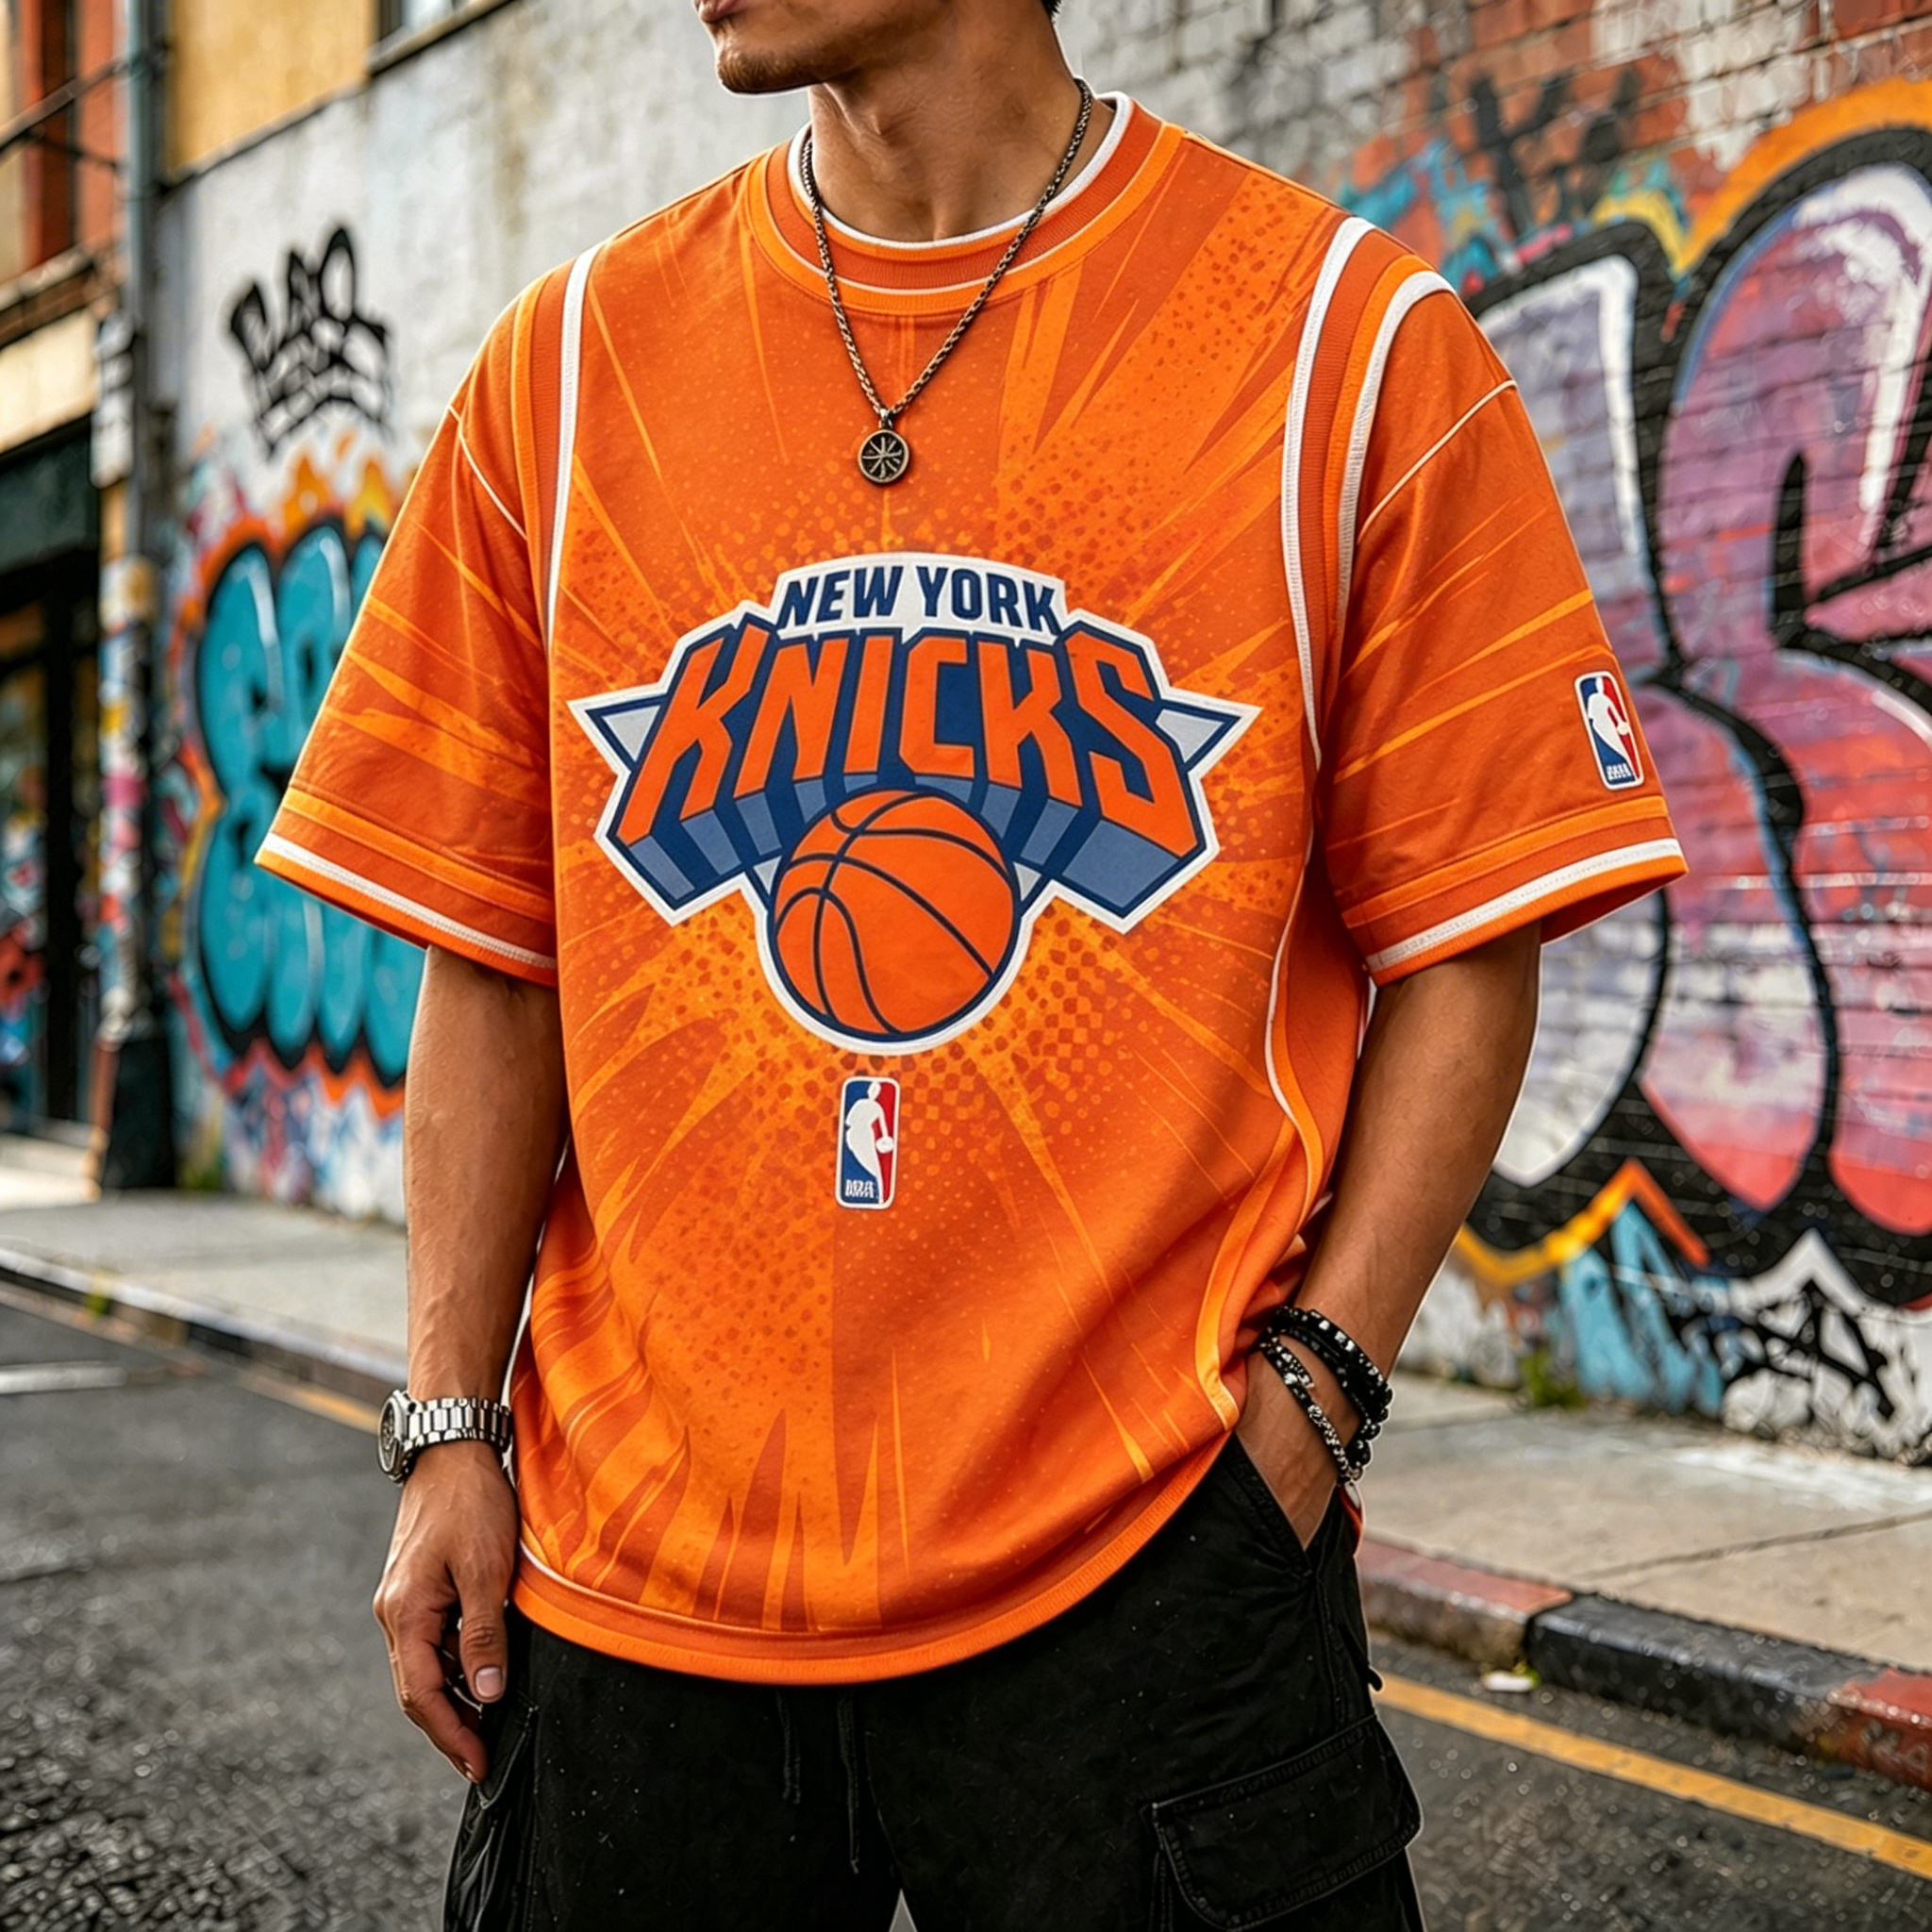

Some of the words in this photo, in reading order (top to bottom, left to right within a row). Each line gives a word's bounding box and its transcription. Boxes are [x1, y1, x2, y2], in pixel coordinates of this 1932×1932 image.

[776, 565, 904, 631] NEW
[916, 565, 1062, 636] YORK
[615, 621, 1200, 859] KNICKS
